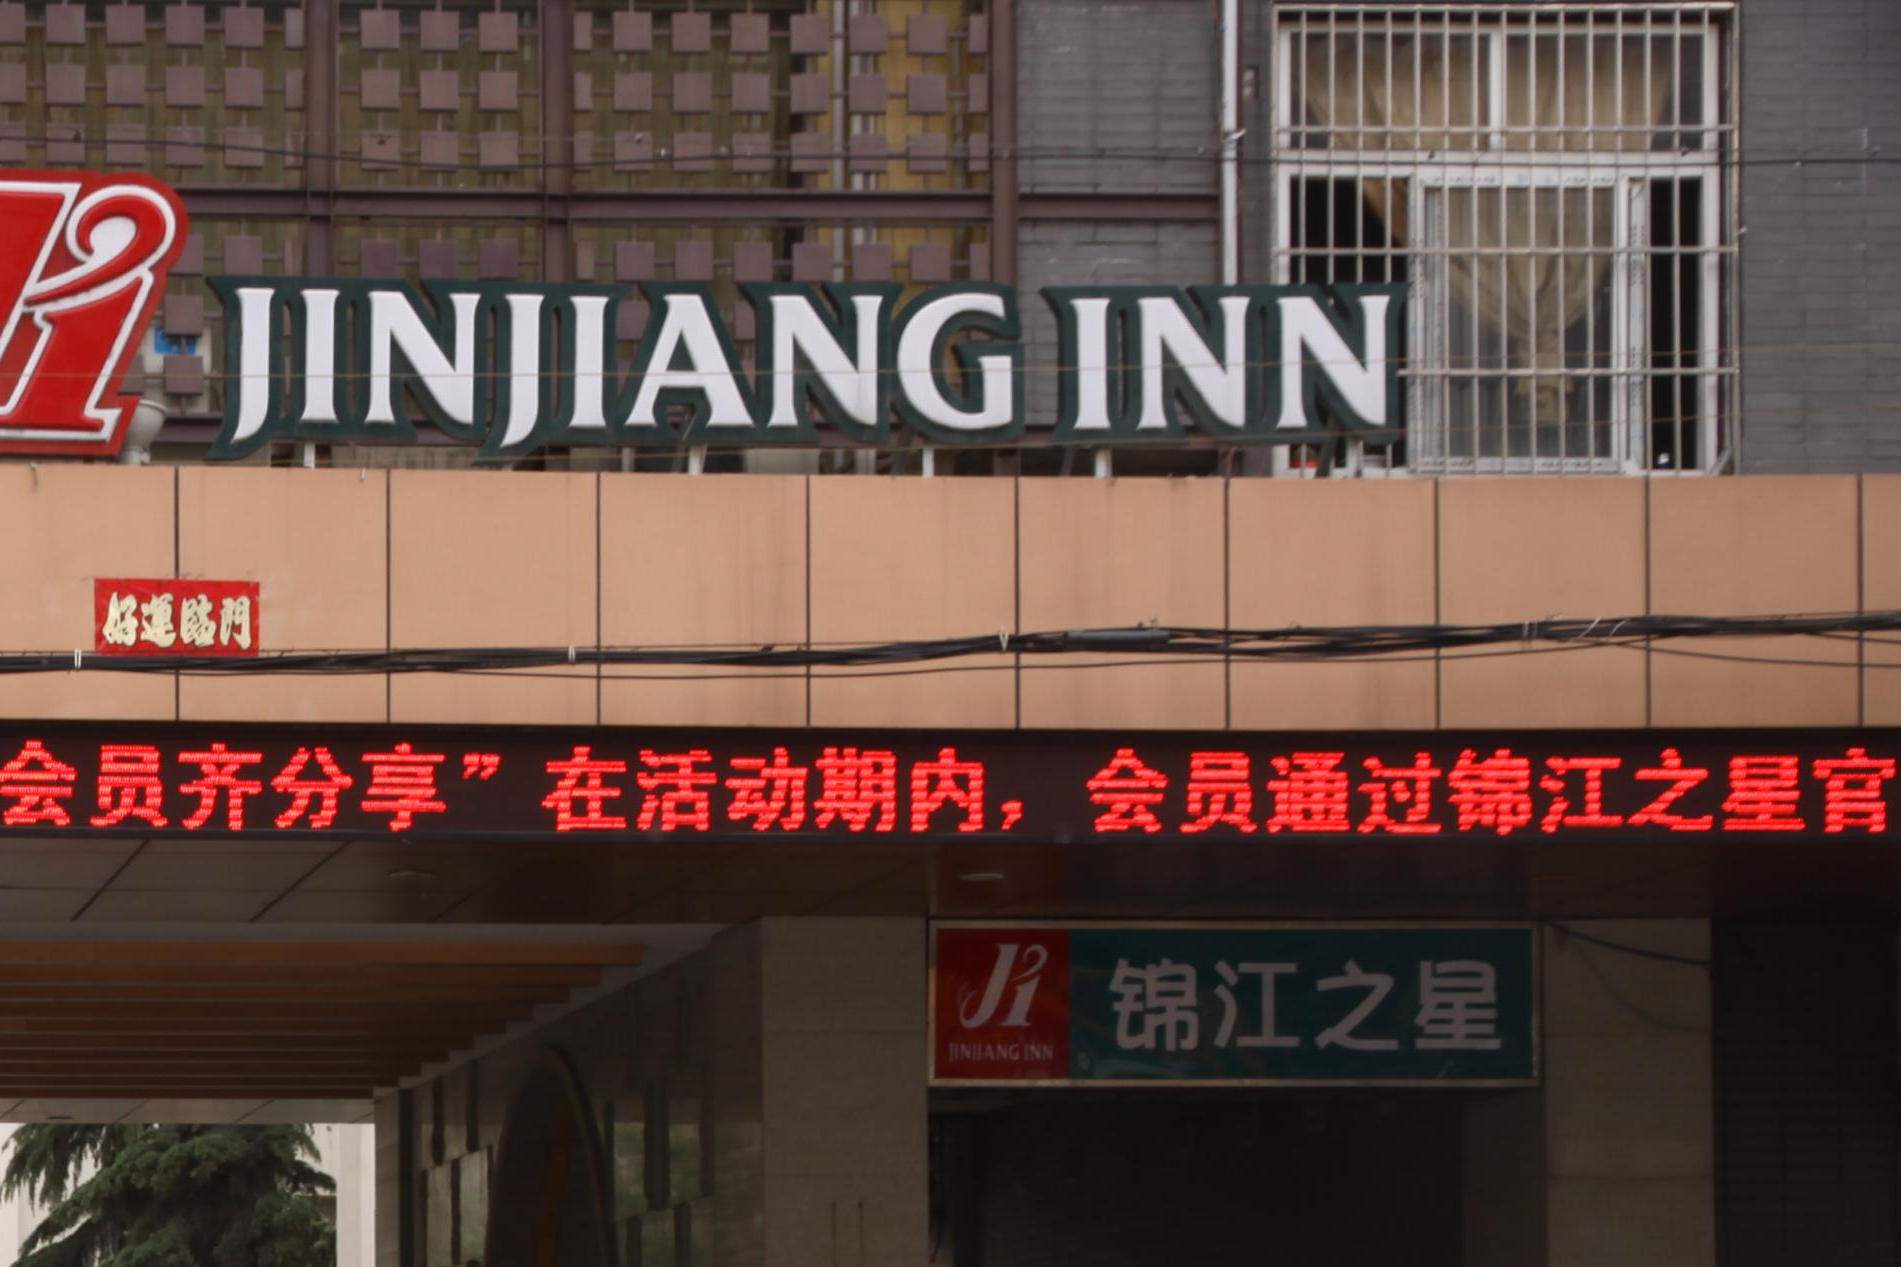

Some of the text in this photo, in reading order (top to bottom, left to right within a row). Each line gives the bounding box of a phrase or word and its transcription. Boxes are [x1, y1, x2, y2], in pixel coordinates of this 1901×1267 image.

[233, 287, 1390, 449] JINJIANG INN
[948, 1043, 1053, 1063] JINJIANG INN
[1108, 957, 1502, 1053] 锦江之星
